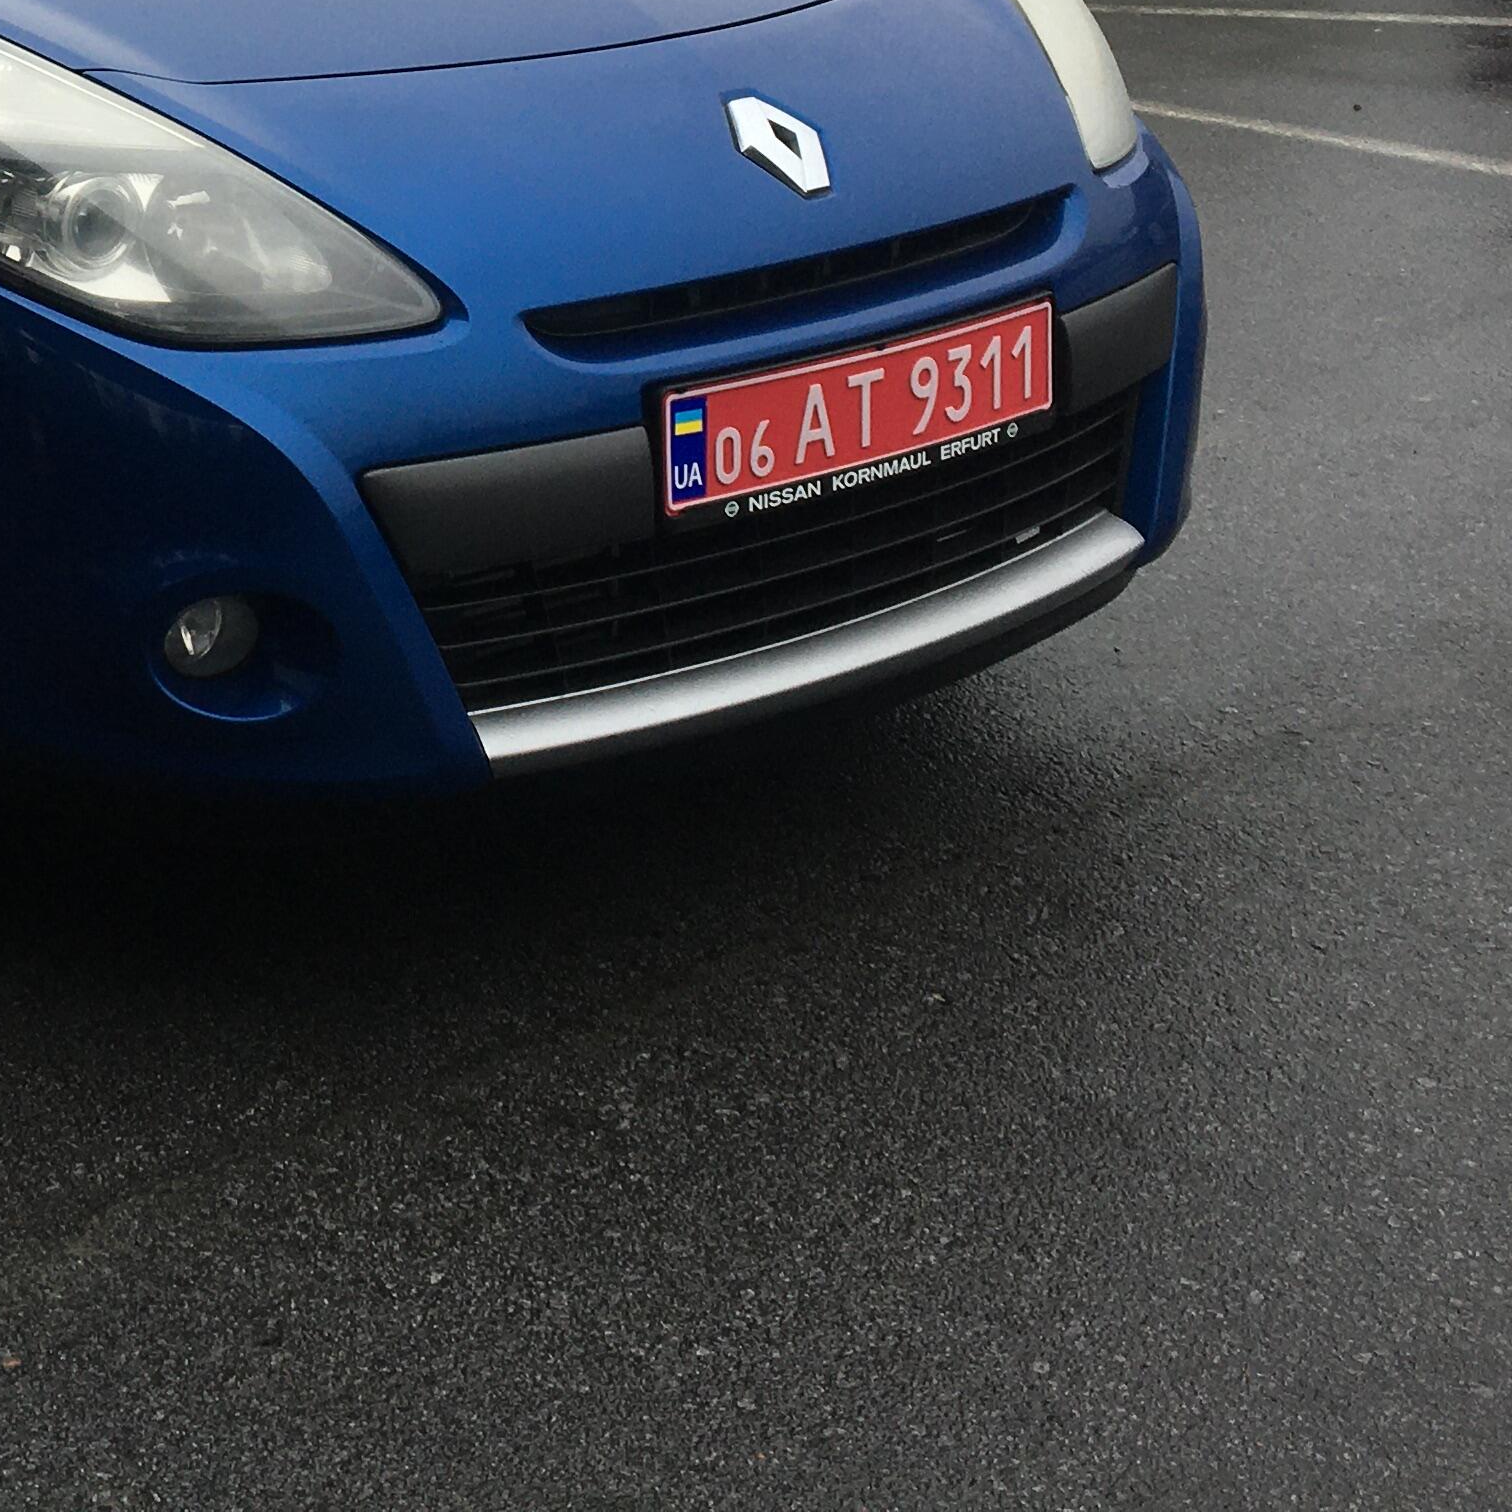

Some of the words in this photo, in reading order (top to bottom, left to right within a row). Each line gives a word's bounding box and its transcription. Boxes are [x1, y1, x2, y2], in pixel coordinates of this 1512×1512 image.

[674, 461, 703, 489] UA
[714, 419, 775, 485] 06
[795, 367, 886, 465] AT
[909, 325, 1033, 435] 9311
[748, 480, 822, 513] NISSAN
[832, 452, 932, 491] KORNMAUL
[940, 427, 1002, 461] ERFURT
